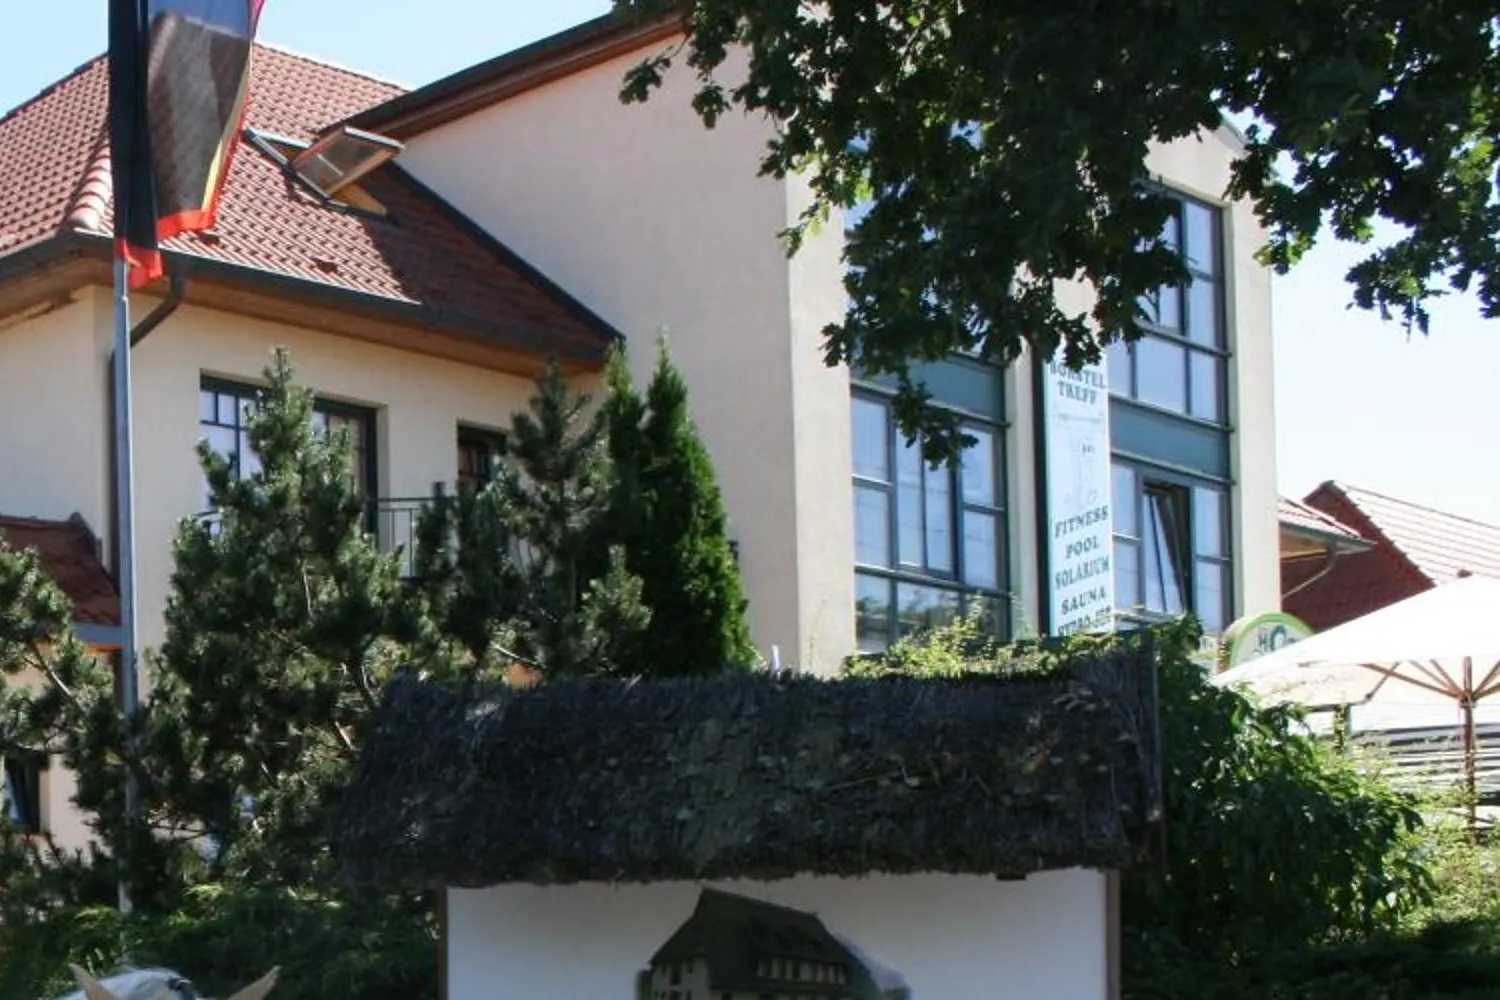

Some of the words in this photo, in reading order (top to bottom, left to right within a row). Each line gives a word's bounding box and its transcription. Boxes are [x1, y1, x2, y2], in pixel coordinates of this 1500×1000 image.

[1057, 380, 1098, 405] TREFF
[1055, 505, 1110, 539] FITNESS
[1065, 534, 1100, 559] POOL
[1055, 555, 1110, 590] SOLARIUM
[1061, 585, 1108, 615] SAUNA
